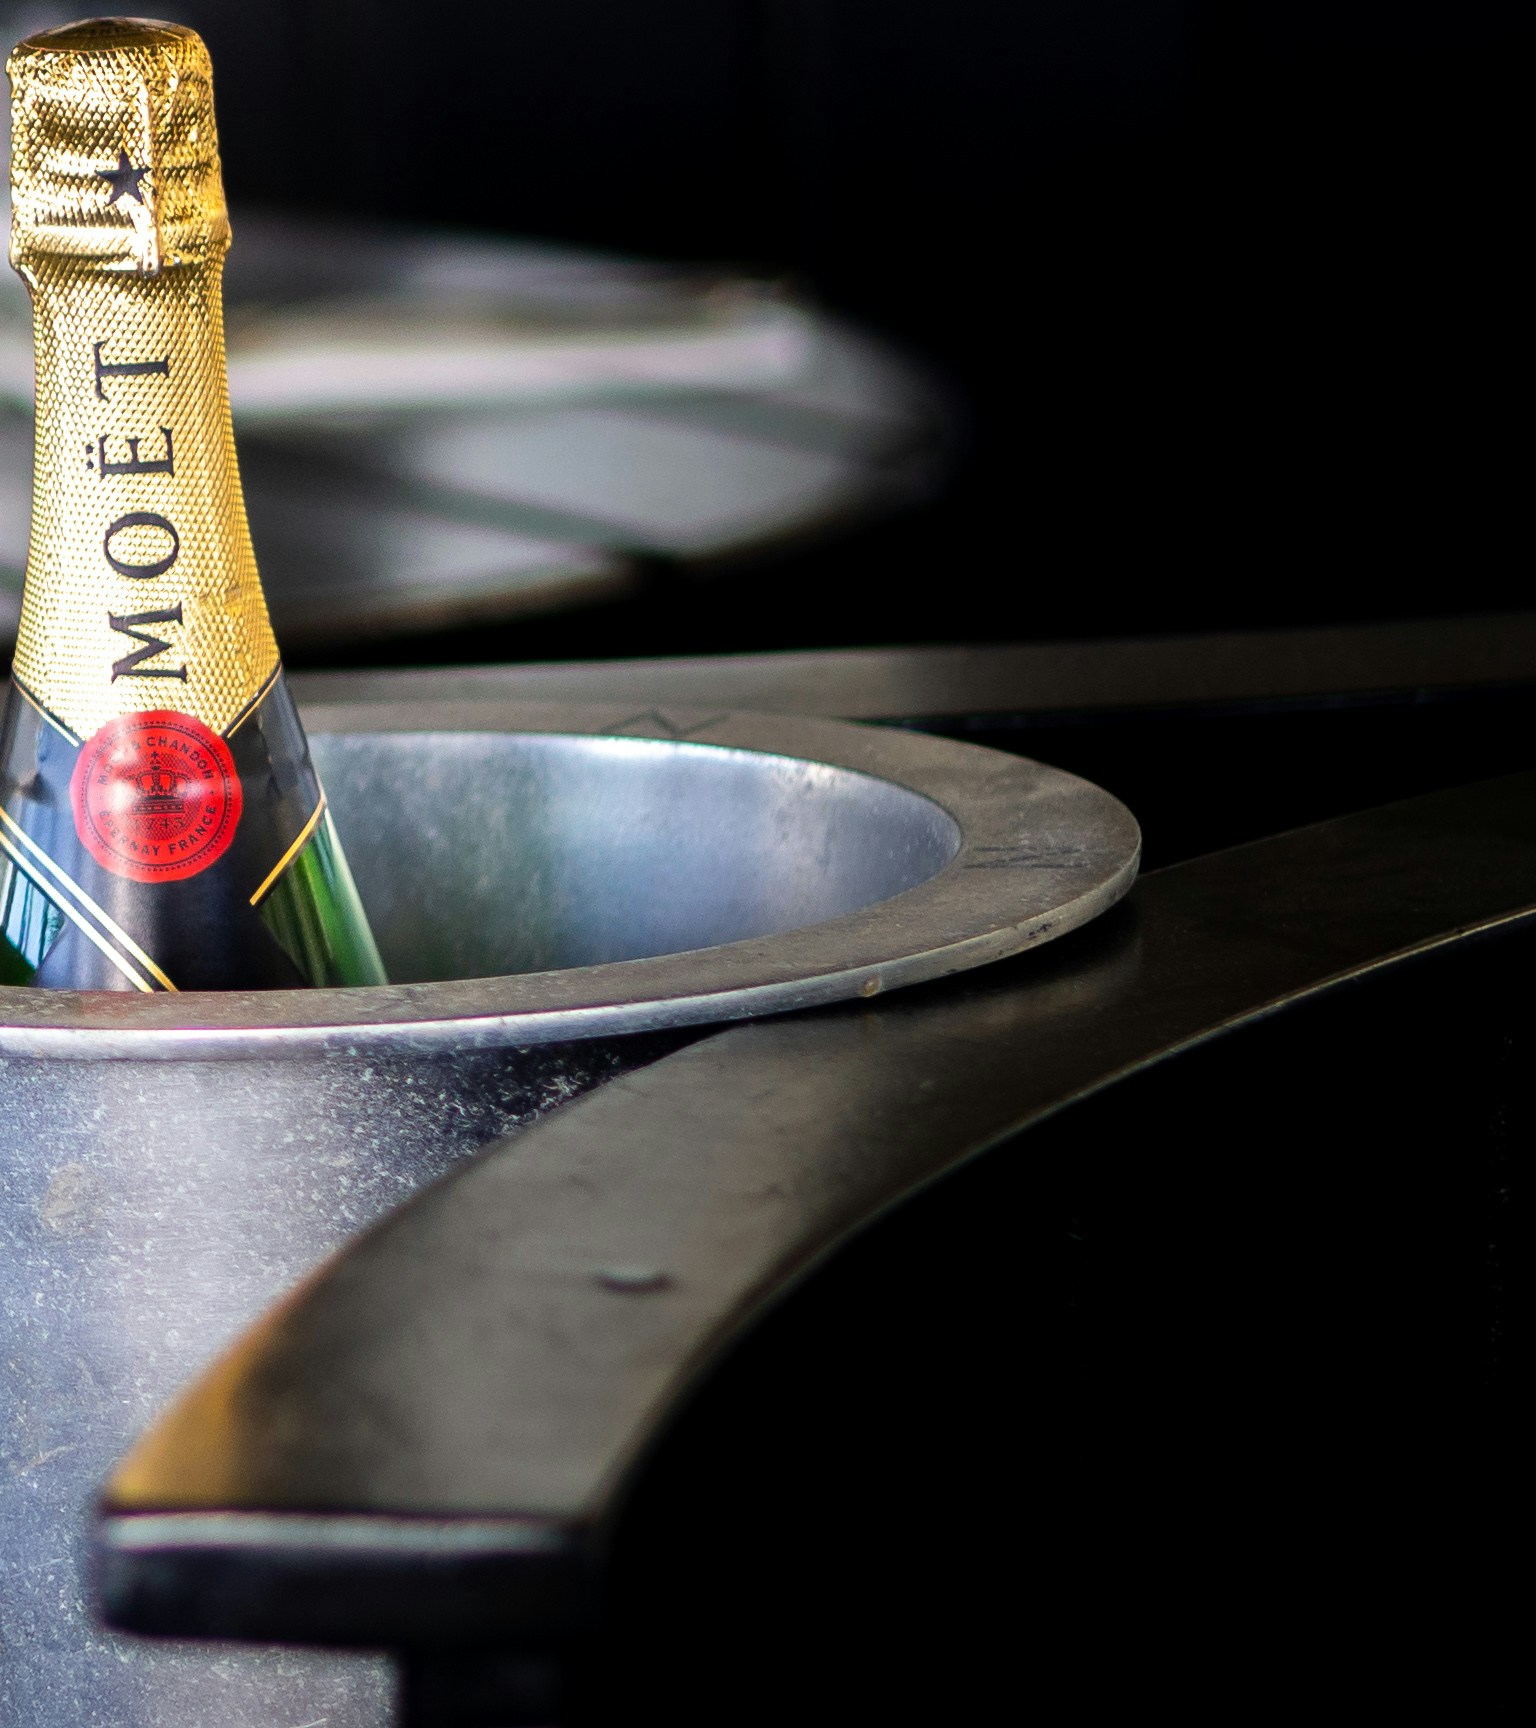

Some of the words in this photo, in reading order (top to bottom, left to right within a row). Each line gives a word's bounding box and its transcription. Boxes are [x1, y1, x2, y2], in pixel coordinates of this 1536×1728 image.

[84, 340, 188, 685] MOËT
[145, 735, 215, 781] CHANDON
[167, 804, 218, 856] FRANCE
